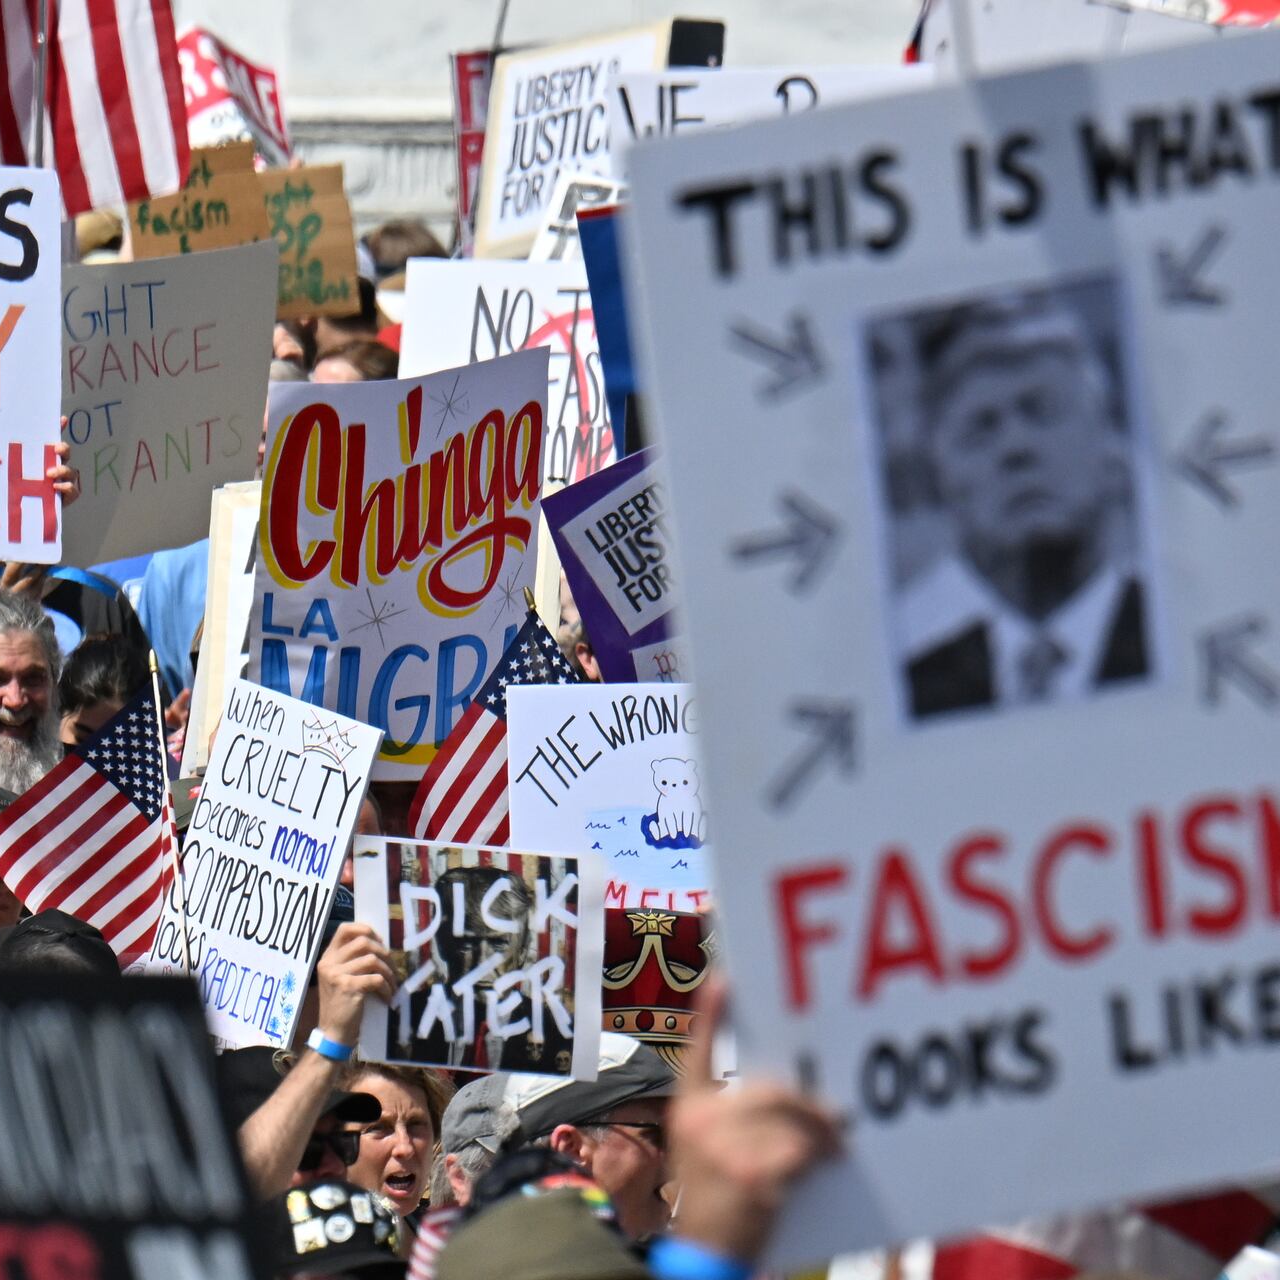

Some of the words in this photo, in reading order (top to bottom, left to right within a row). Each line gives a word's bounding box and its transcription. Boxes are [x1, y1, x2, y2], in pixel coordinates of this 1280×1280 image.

[514, 60, 603, 119] LIBERTY
[507, 103, 610, 176] JUSTIC
[500, 173, 544, 220] FOR
[673, 147, 911, 280] THIS
[957, 131, 1046, 239] IS
[63, 280, 166, 345] GHT
[471, 285, 534, 366] NO
[68, 321, 220, 395] RANCE
[68, 401, 122, 445] OT
[76, 414, 244, 496] RANTS
[260, 385, 543, 615] Chinga
[262, 591, 340, 641] LA
[622, 562, 677, 613] FOR
[260, 624, 520, 755] MIGR
[220, 732, 362, 828] CRUELTY
[515, 715, 603, 808] THE
[193, 782, 265, 852] becomes
[270, 825, 337, 880] normal
[170, 840, 331, 965] COMPASSION
[398, 872, 580, 953] DICK
[201, 946, 282, 1039] RADICAL
[387, 953, 576, 1049] TATER
